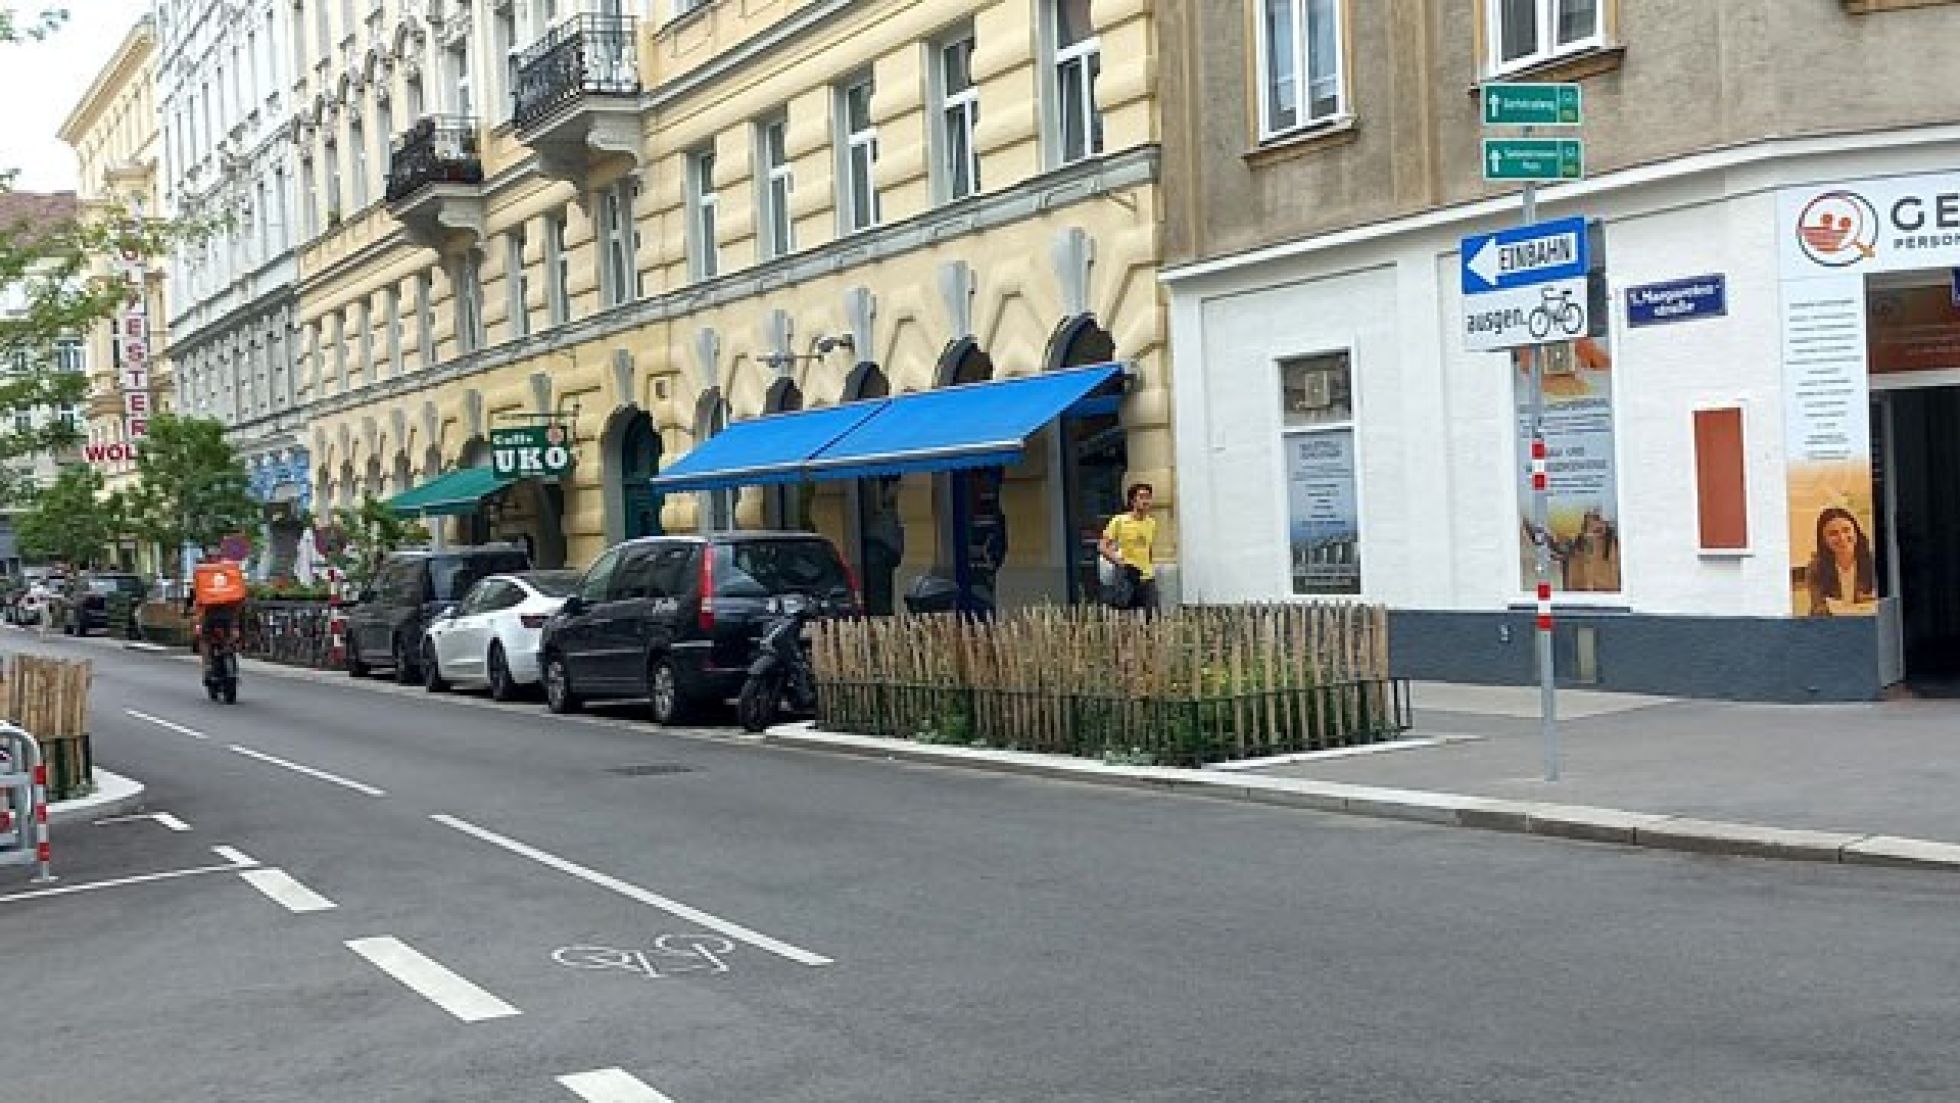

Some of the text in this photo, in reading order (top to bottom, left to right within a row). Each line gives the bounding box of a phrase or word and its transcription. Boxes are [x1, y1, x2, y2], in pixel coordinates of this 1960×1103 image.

[1890, 193, 1960, 233] GE
[1498, 238, 1571, 271] EINBAHN
[1466, 308, 1529, 335] ausgen.
[492, 447, 568, 473] UKO
